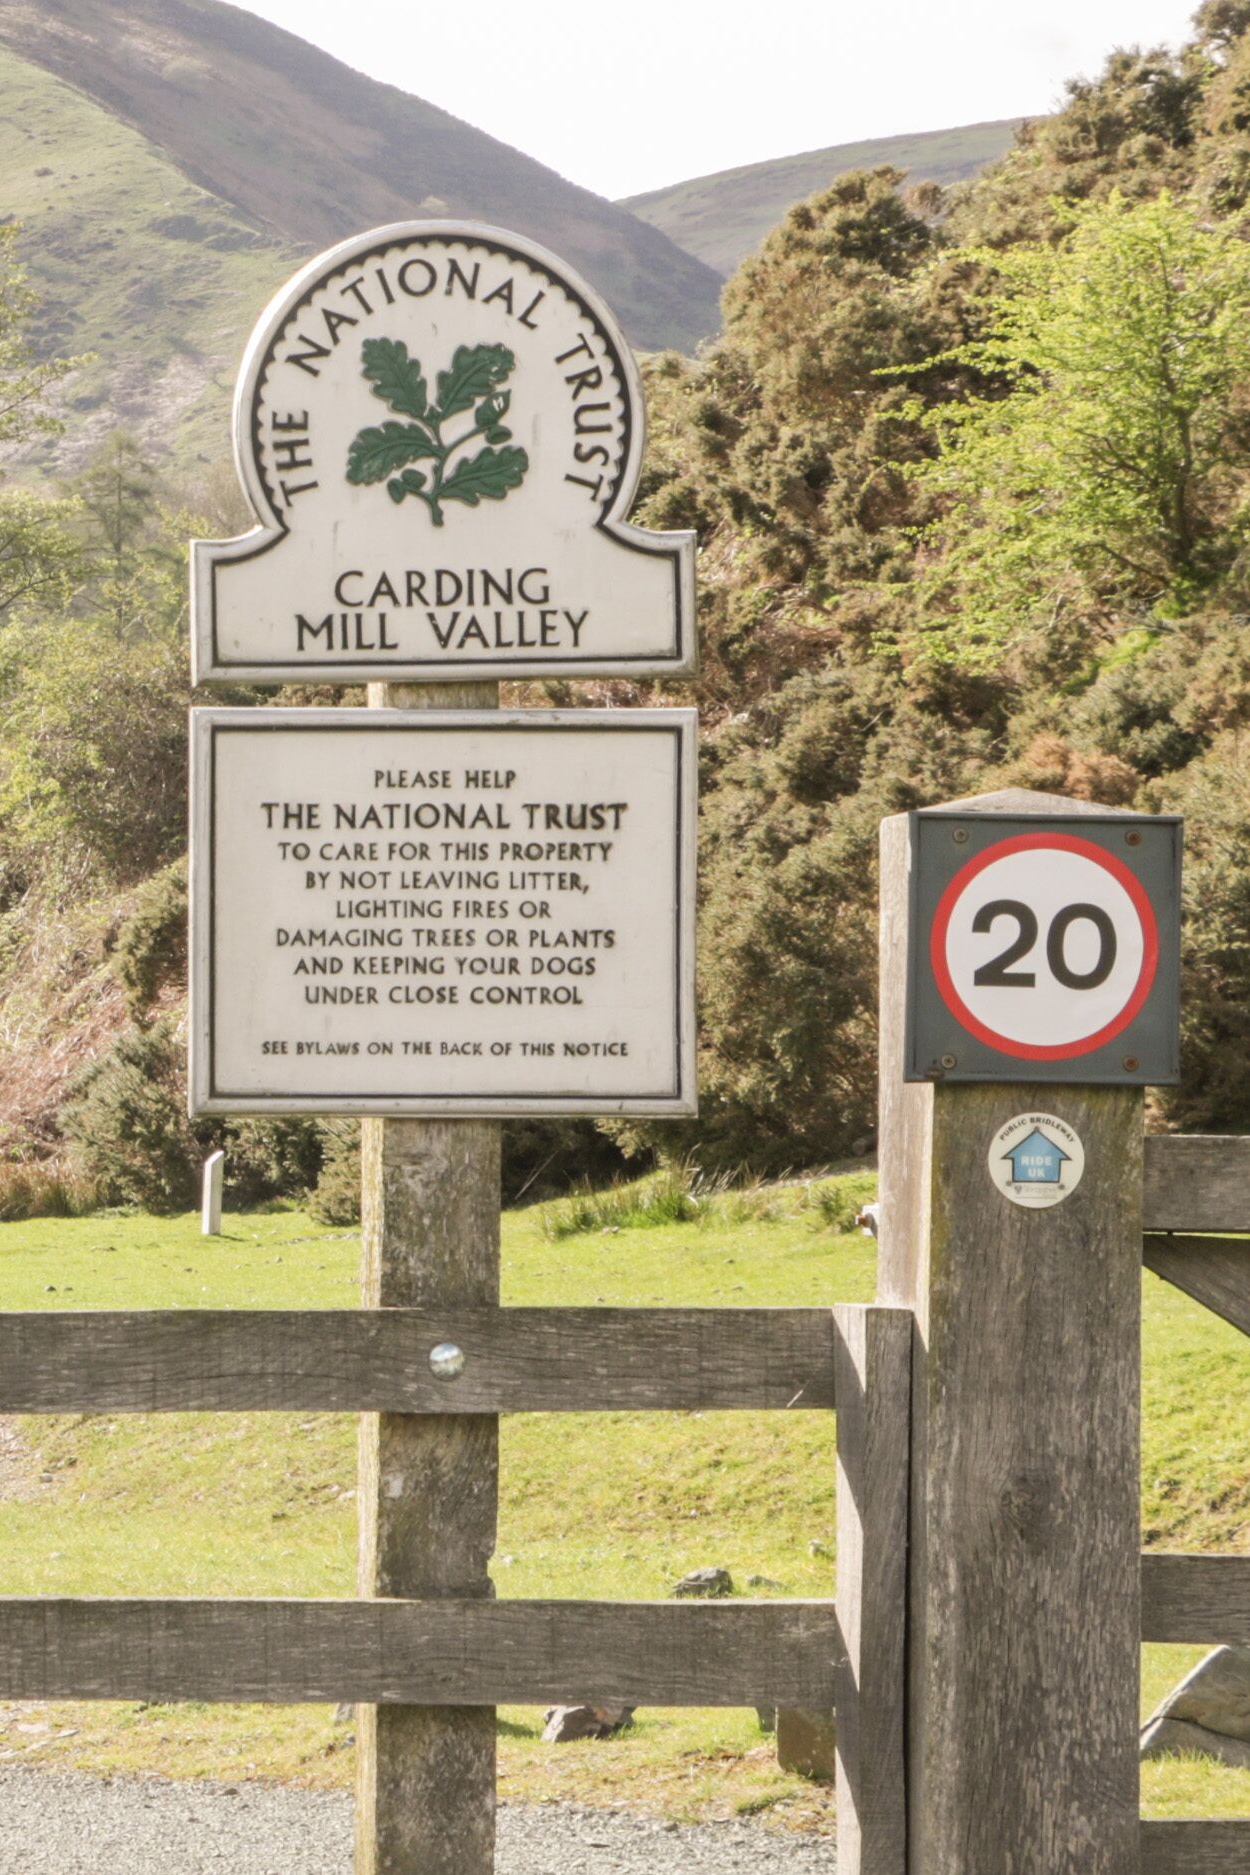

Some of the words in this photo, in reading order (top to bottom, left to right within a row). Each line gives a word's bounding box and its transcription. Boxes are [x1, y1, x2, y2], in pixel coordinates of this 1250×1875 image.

[287, 259, 545, 377] NATIONAL
[554, 333, 612, 502] TRUST
[272, 410, 318, 507] THE
[335, 568, 549, 607] CARDING
[295, 613, 398, 651] MILL
[427, 610, 588, 649] VALLEY
[375, 770, 451, 788] PLEASE
[465, 770, 516, 789] HELP
[261, 803, 320, 829] THE
[334, 803, 510, 829] NATIONAL
[522, 803, 627, 830] TRUST
[278, 842, 310, 861] TO
[320, 843, 378, 861] CARE
[388, 842, 430, 860] FOR
[441, 843, 488, 861] THIS
[500, 842, 612, 861] PROPERTY
[306, 871, 330, 889] BY
[340, 871, 391, 889] NOT
[401, 871, 499, 889] LEAVING
[510, 872, 589, 894] LITTER,
[337, 900, 442, 918] LIGHTING
[454, 900, 508, 918] FIRES
[519, 901, 551, 918] OR
[277, 928, 402, 947] DAMAGING
[415, 929, 475, 946] TREES
[486, 929, 518, 947] OR
[530, 930, 615, 948] PLANTS
[972, 900, 1117, 990] 20
[294, 957, 343, 974] AND
[354, 957, 444, 974] KEEPING
[455, 957, 520, 975] YOUR
[532, 957, 595, 976] DOGS
[305, 986, 378, 1004] UNDER
[389, 986, 458, 1004] CLOSE
[470, 986, 583, 1005] CONTROL
[262, 1041, 288, 1054] SEE
[296, 1042, 359, 1055] BYLAWS
[367, 1042, 393, 1055] ON
[402, 1042, 432, 1055] THE
[440, 1042, 482, 1055] BACK
[490, 1042, 511, 1056] OF
[520, 1043, 555, 1056] THIS
[563, 1043, 628, 1057] NOTICE
[1000, 1119, 1027, 1141] PUBLIC
[1029, 1117, 1074, 1142] BRIDLEWAY
[1021, 1156, 1052, 1166] RIDE
[1028, 1168, 1045, 1177] UK
